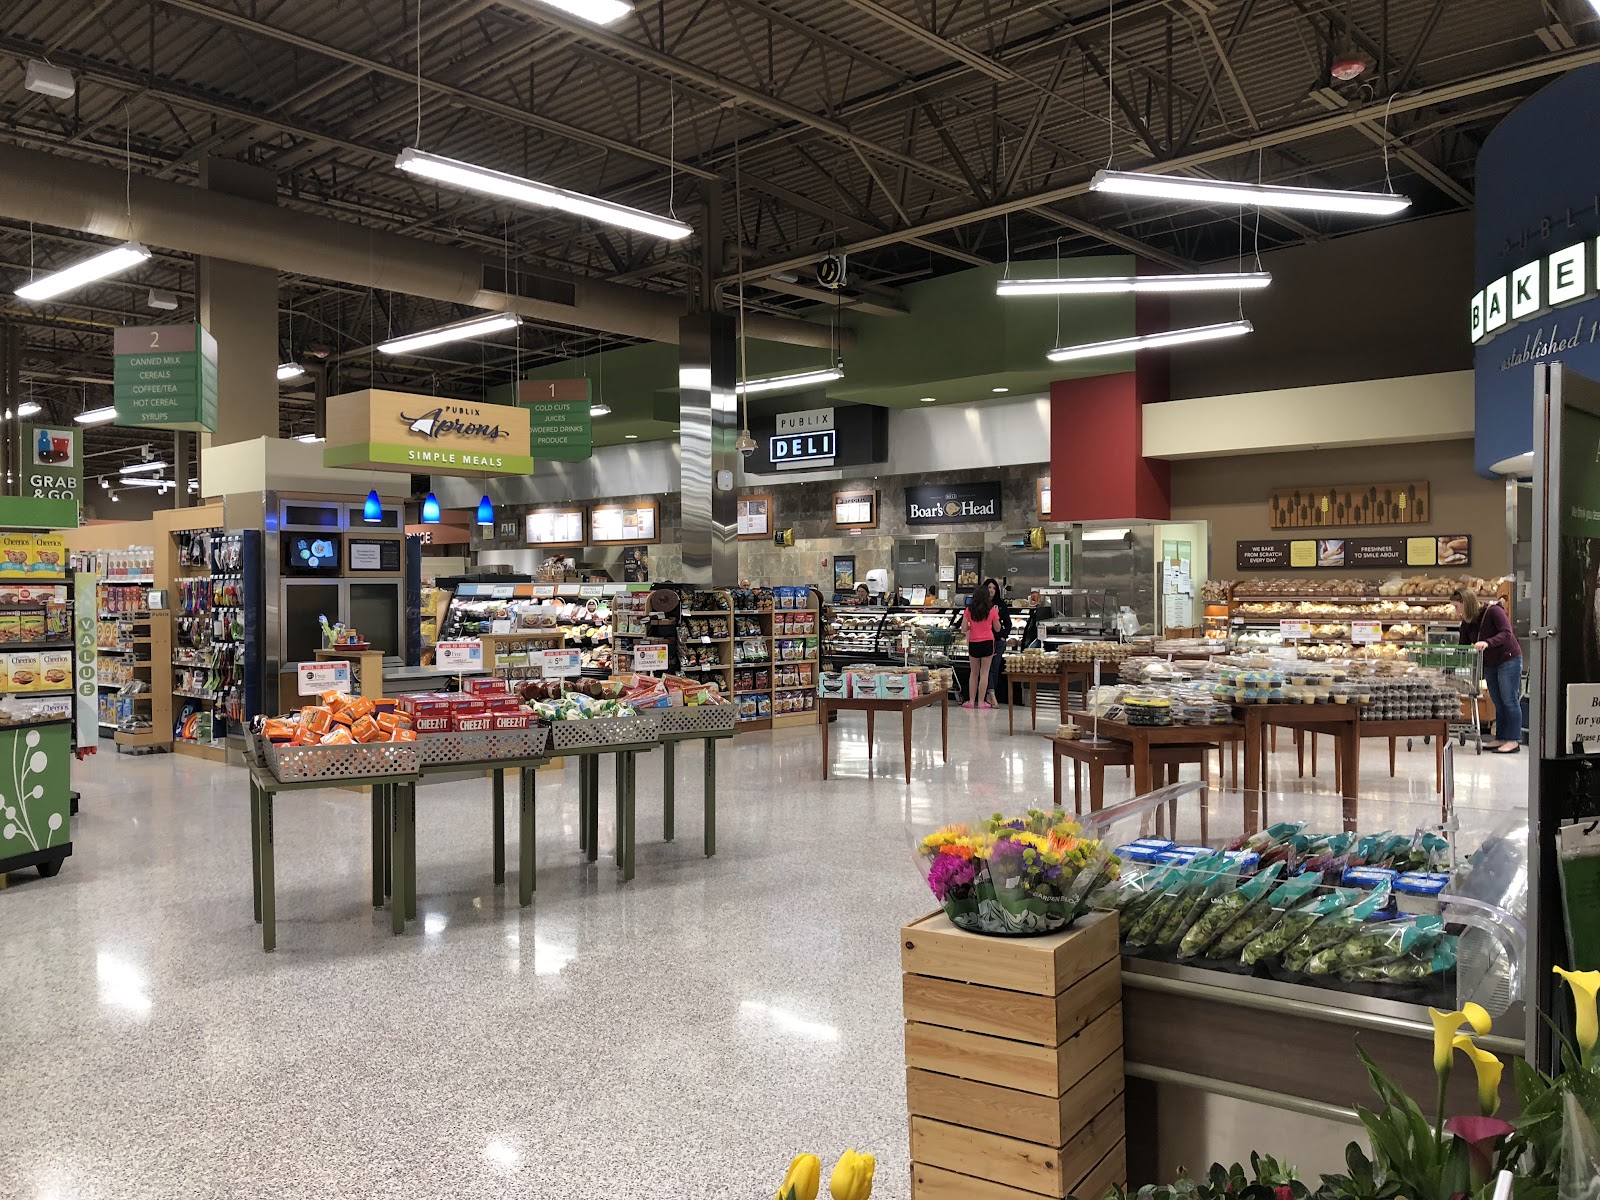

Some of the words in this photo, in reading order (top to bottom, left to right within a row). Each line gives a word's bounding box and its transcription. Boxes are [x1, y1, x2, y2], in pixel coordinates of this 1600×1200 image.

[1472, 258, 1575, 331] BAKE
[150, 331, 159, 348] 2
[1501, 315, 1585, 372] established
[1589, 321, 1600, 343] 1
[130, 357, 162, 366] CANNED
[163, 356, 181, 365] MILK
[139, 370, 171, 380] CEREALS
[132, 384, 178, 394] COFFEE/TEA
[548, 383, 555, 398] 1
[133, 399, 149, 407] HOT
[150, 398, 178, 407] CEREAL
[534, 404, 553, 412] COLD
[553, 403, 570, 411] CUTS
[141, 412, 168, 421] SYRUPS
[445, 405, 480, 417] PUBLIX
[400, 407, 510, 439] Aprons
[781, 414, 828, 429] PUBLIX
[537, 436, 568, 444] PRODUCE
[776, 435, 829, 457] DELI
[408, 450, 456, 463] SIMPLE
[462, 454, 502, 467] MEALS
[30, 474, 77, 489] GRAB
[33, 488, 45, 499] &
[48, 489, 74, 500] GO
[910, 502, 944, 518] Boar's
[961, 499, 994, 516] Head
[3, 537, 30, 546] Cheerios
[36, 538, 62, 547] Cheerios
[11, 657, 37, 665] Cheerios
[43, 655, 68, 663] Cheerios
[81, 620, 91, 694] VALUE
[1591, 696, 1600, 708] B
[416, 718, 448, 730] CHEEZ-IT
[459, 718, 491, 731] CHEEZ-IT
[496, 716, 528, 728] CHEEZ-IT
[1575, 714, 1589, 726] for
[1575, 733, 1596, 742] Please
